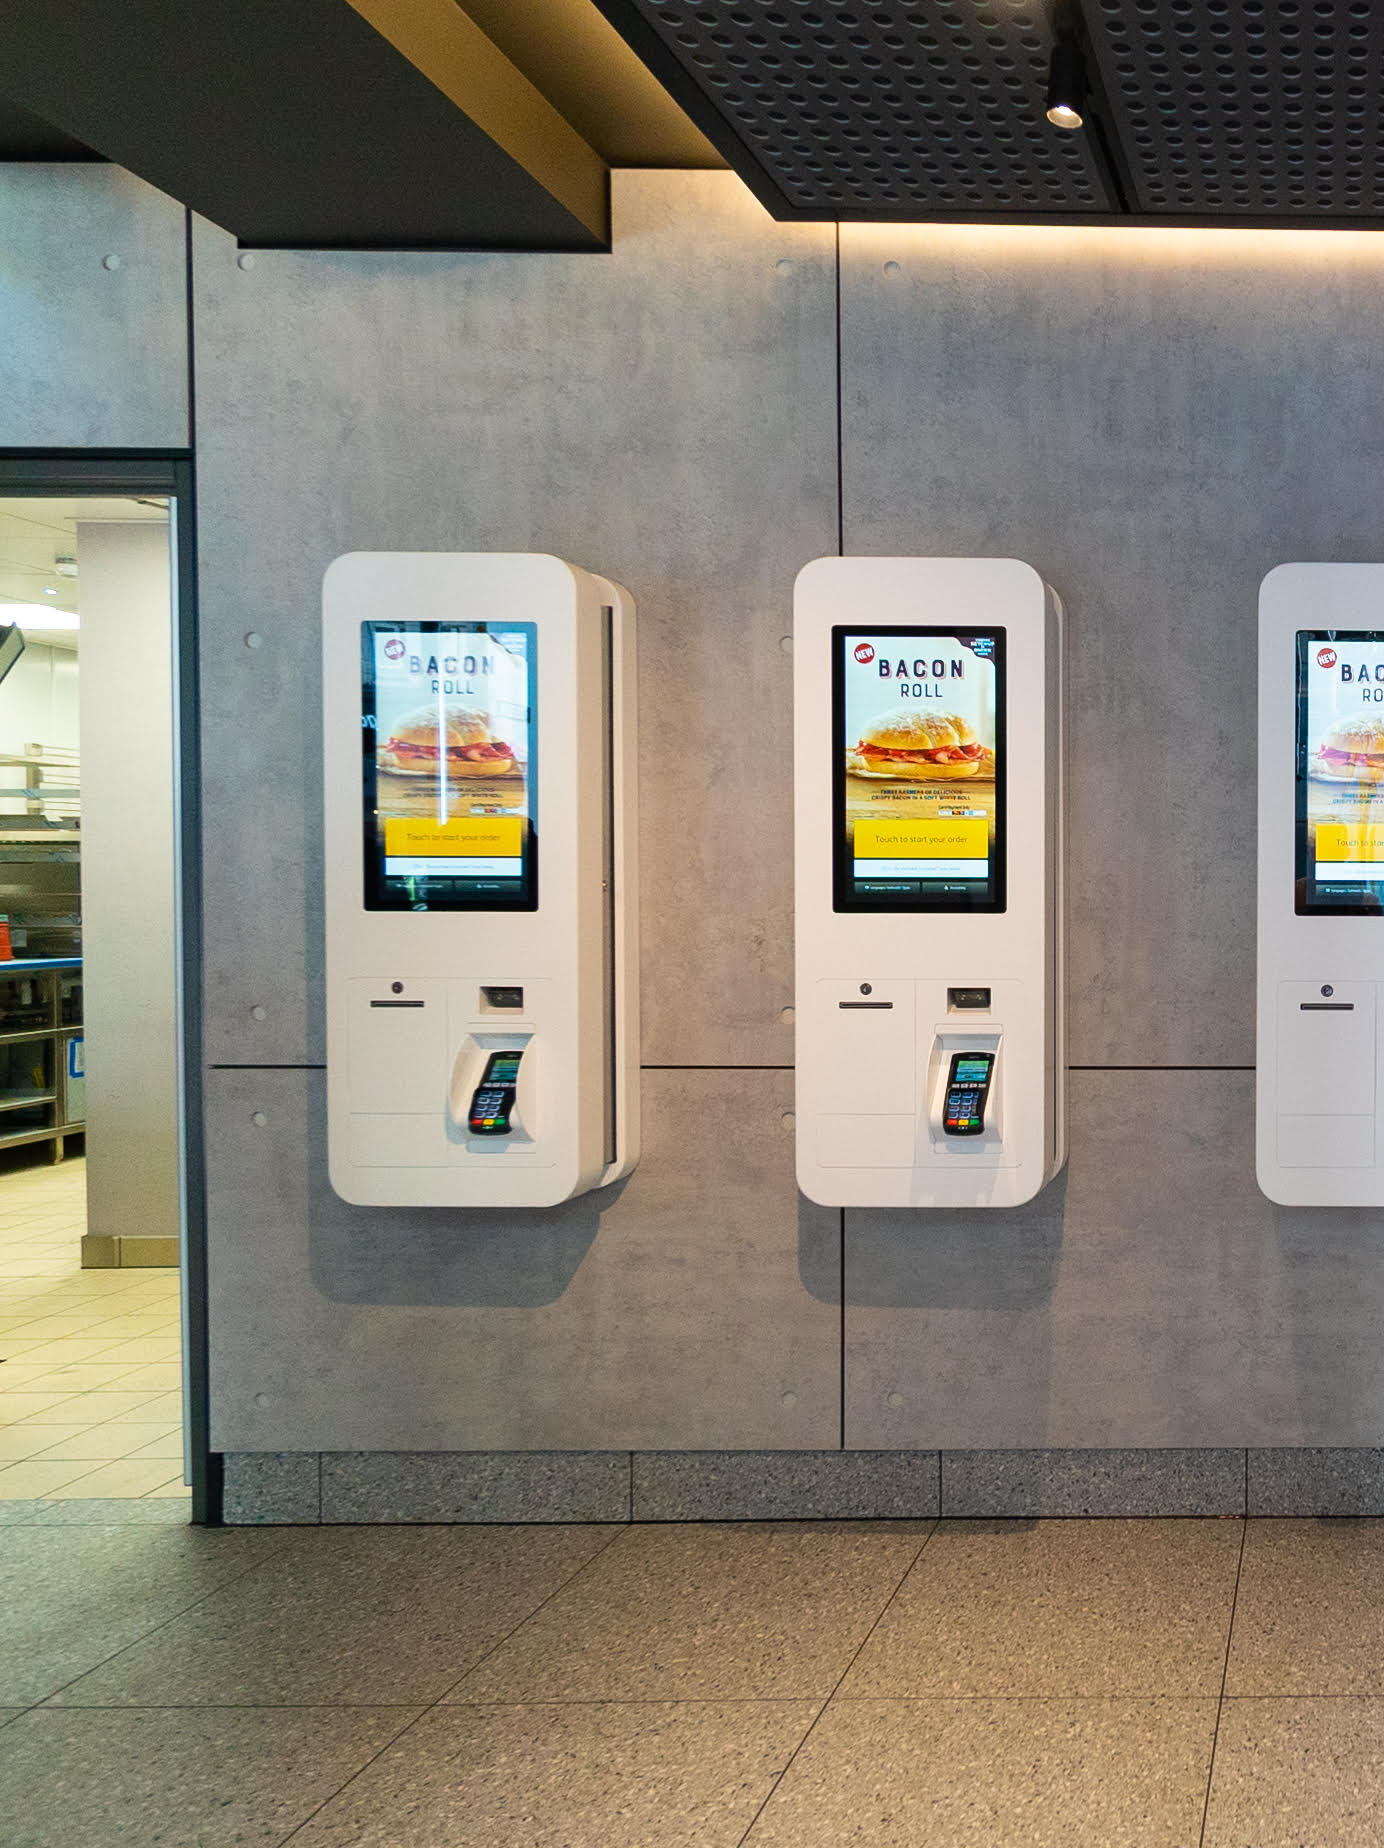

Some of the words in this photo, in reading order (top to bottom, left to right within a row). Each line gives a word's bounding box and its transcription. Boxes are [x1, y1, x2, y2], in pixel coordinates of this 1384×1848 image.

[855, 647, 874, 660] NEW
[1318, 652, 1336, 666] NEW
[409, 656, 495, 674] BACON
[878, 659, 964, 678] BACON
[431, 680, 475, 694] ROLL
[900, 683, 943, 698] ROLL
[875, 835, 898, 843] Touch
[929, 837, 947, 845] your
[1336, 839, 1359, 847] Touch
